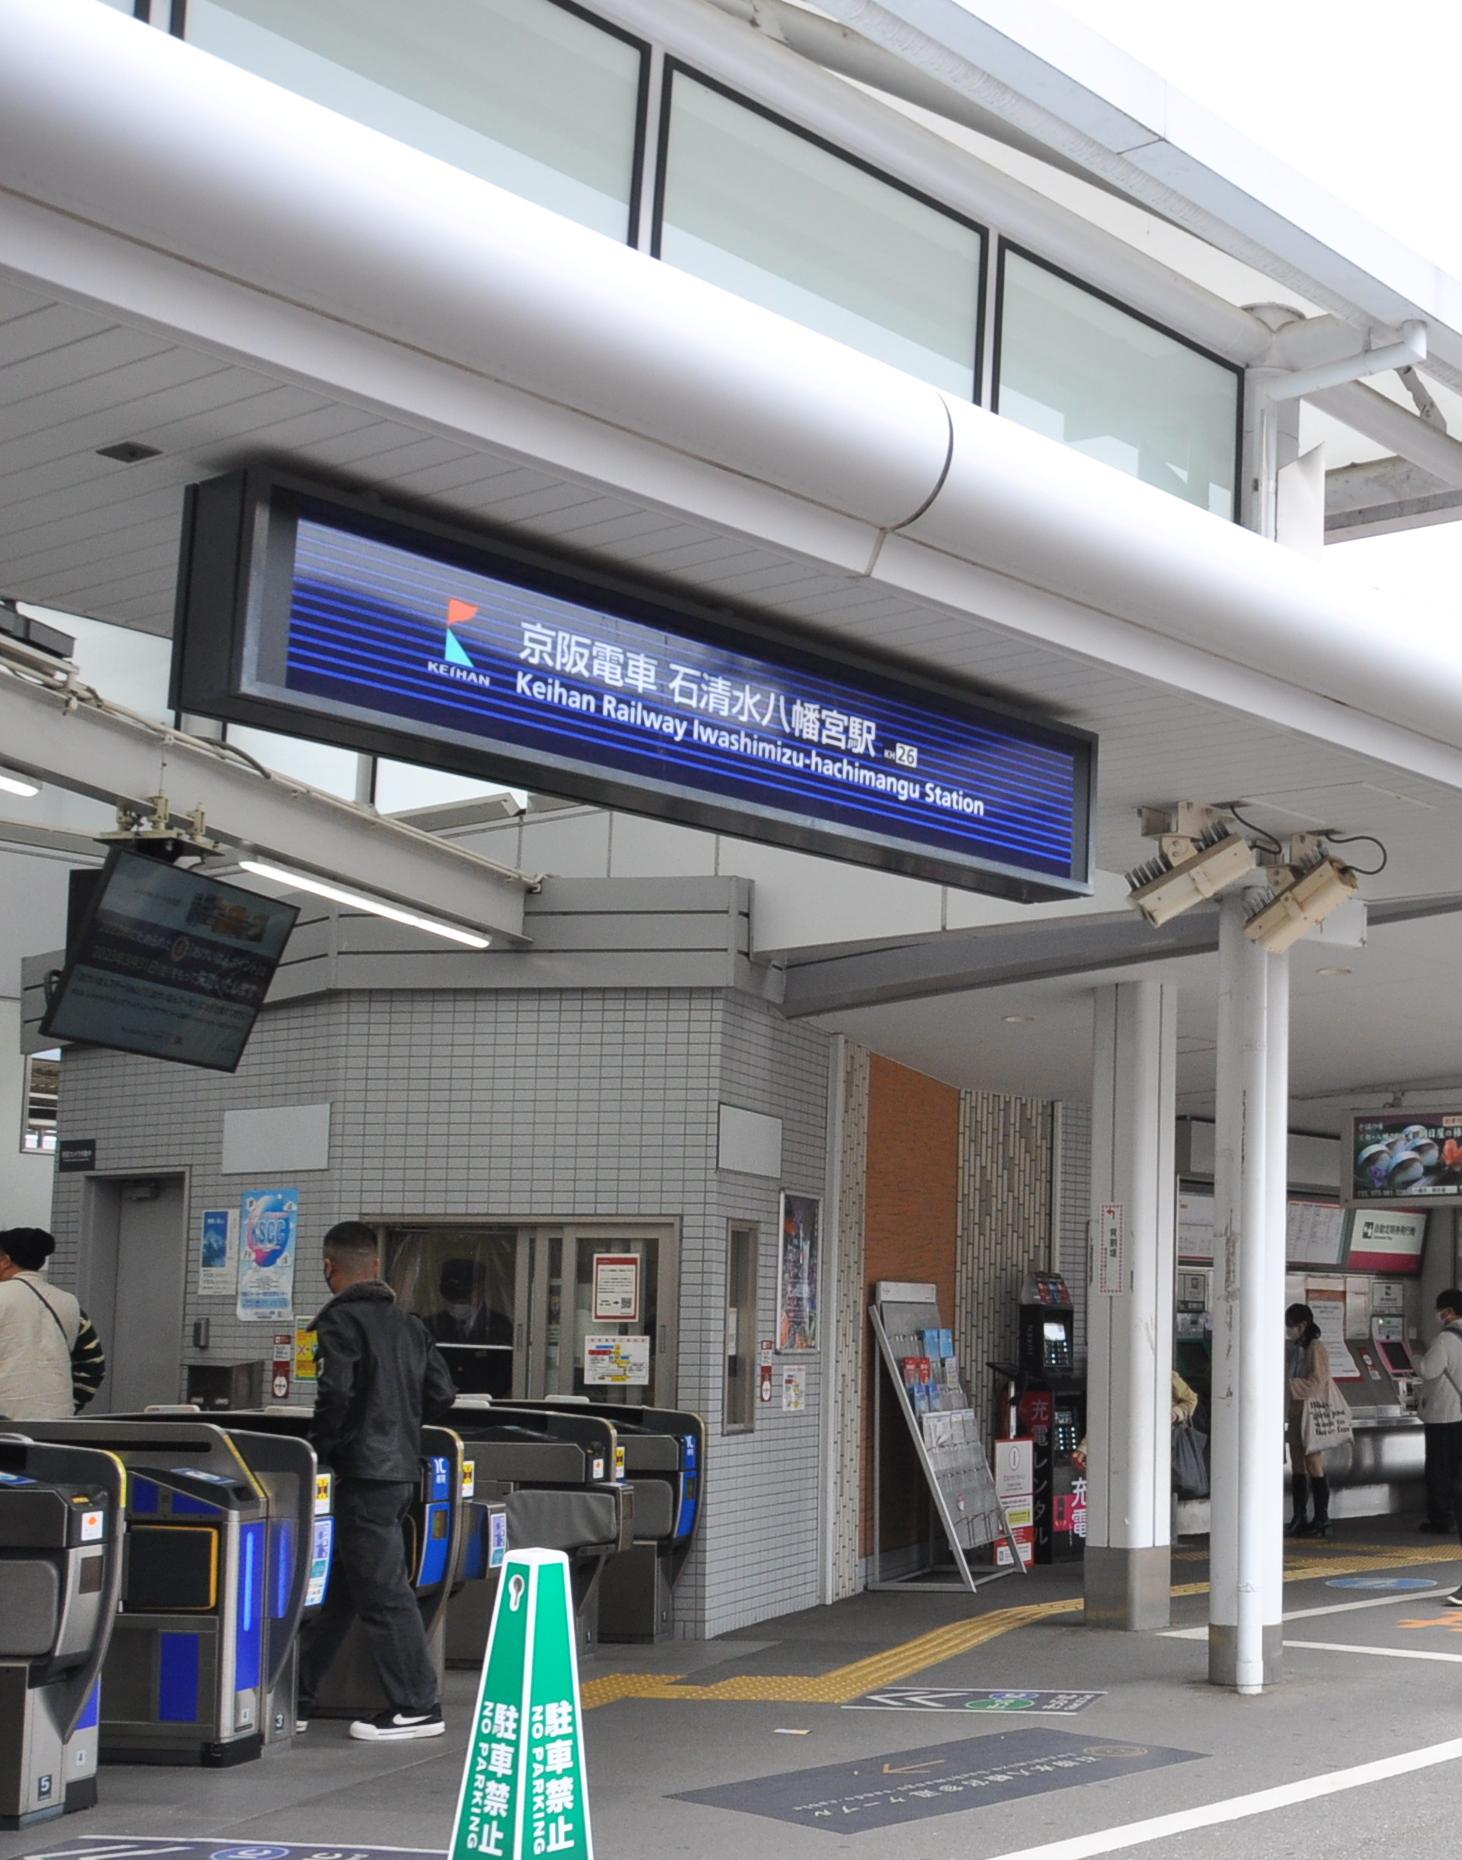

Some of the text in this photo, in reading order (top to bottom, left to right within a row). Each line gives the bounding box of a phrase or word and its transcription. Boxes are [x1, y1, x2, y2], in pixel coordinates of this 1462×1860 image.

[427, 660, 491, 687] KEIHAN
[516, 671, 986, 816] Keihan Railway Iwashimizu-hachimangu Station
[519, 621, 877, 758] 京阪電車 石清水八幡宮駅
[897, 745, 916, 767] 26
[1031, 1399, 1049, 1545] 充電レンタル
[40, 1776, 51, 1792] 5
[275, 1713, 284, 1728] 3
[466, 1701, 495, 1850] NO PARKING
[477, 1702, 520, 1857] 駐車禁止
[531, 1705, 546, 1856] NO PARKING
[544, 1699, 575, 1854] 駐車禁止
